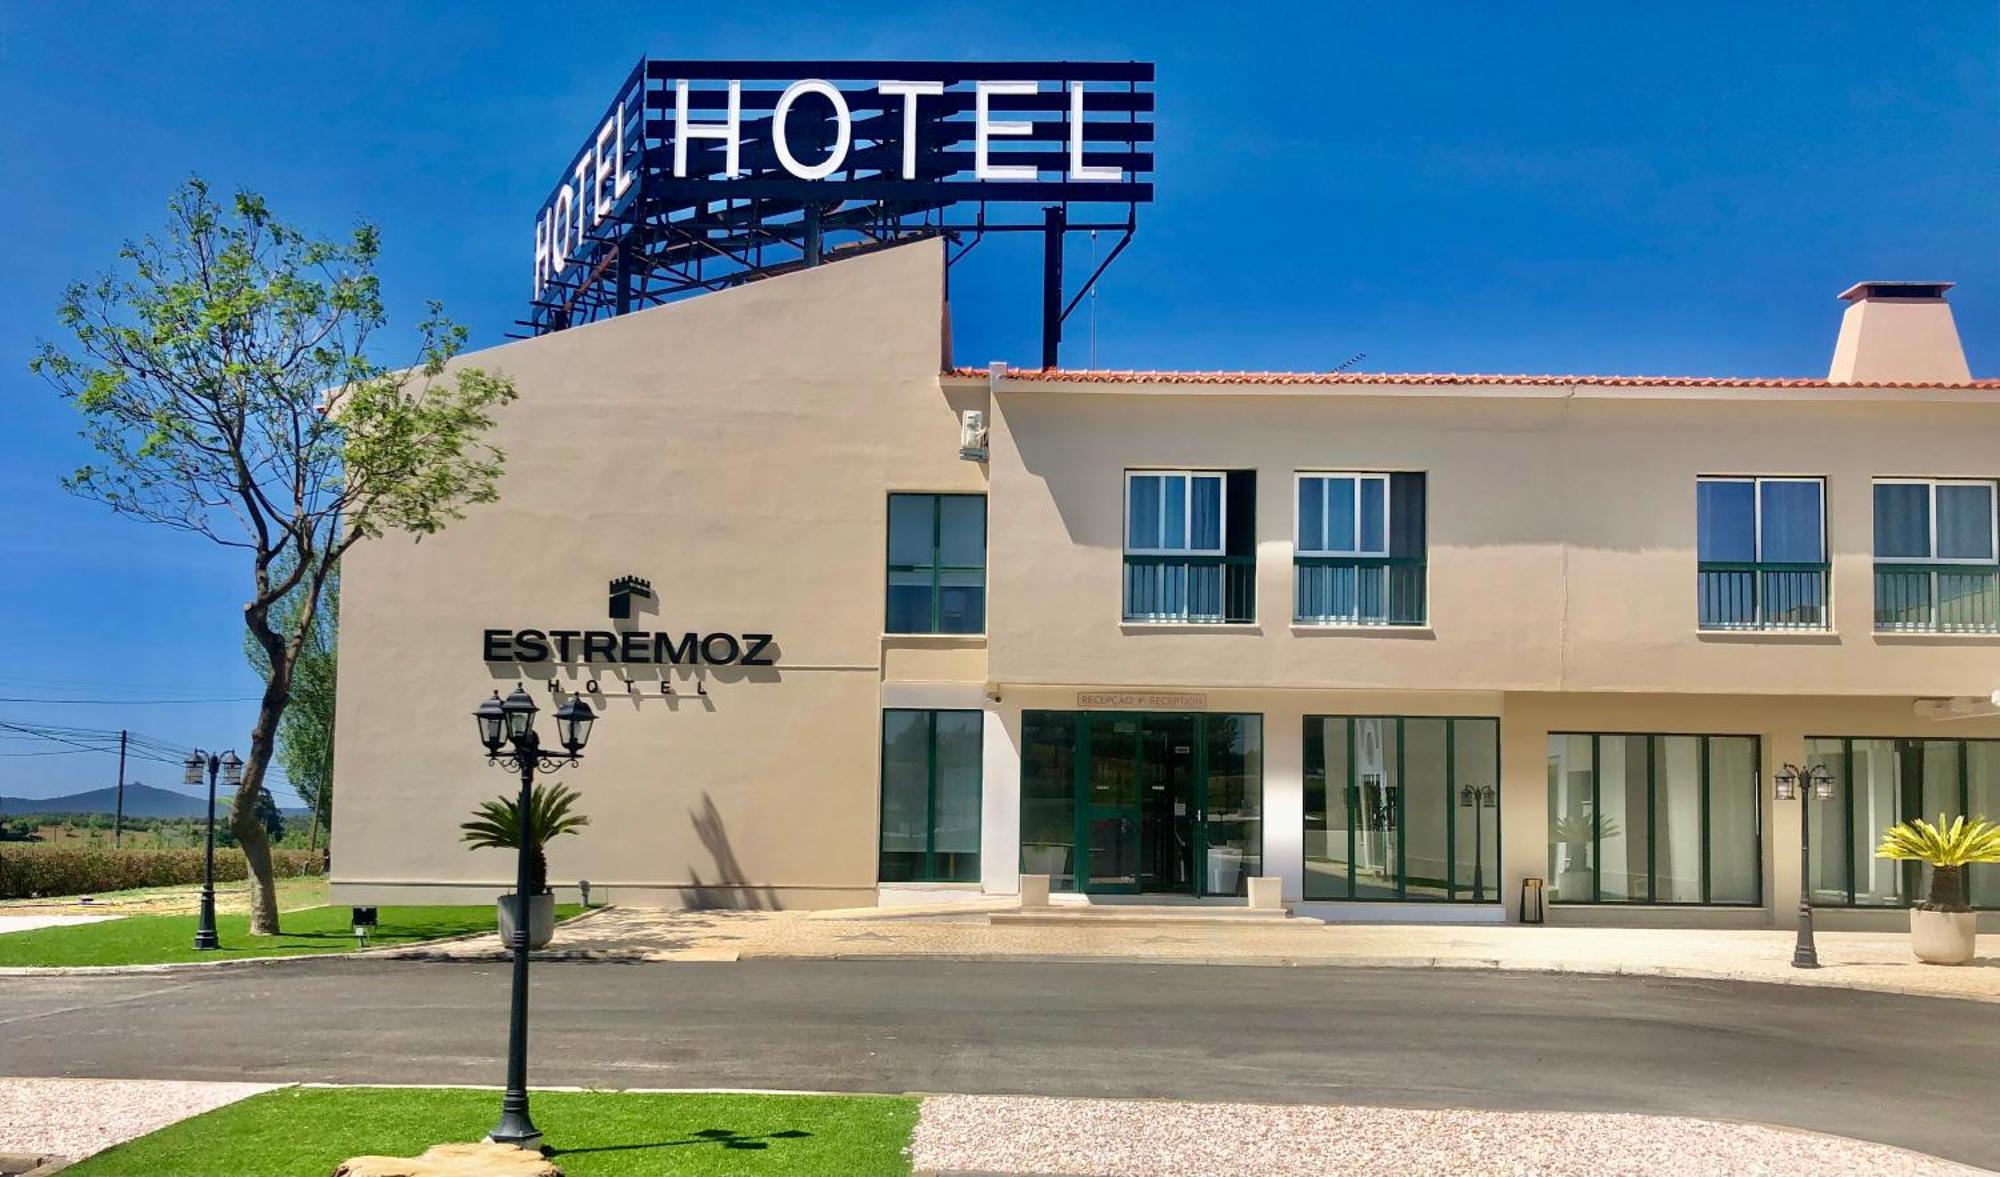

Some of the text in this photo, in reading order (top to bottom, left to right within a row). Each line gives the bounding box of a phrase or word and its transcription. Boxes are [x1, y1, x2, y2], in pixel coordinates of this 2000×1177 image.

[673, 78, 1124, 181] HOTEL
[534, 102, 632, 302] HOTEL
[483, 629, 774, 666] ESTREMOZ
[547, 679, 708, 695] HOTEL
